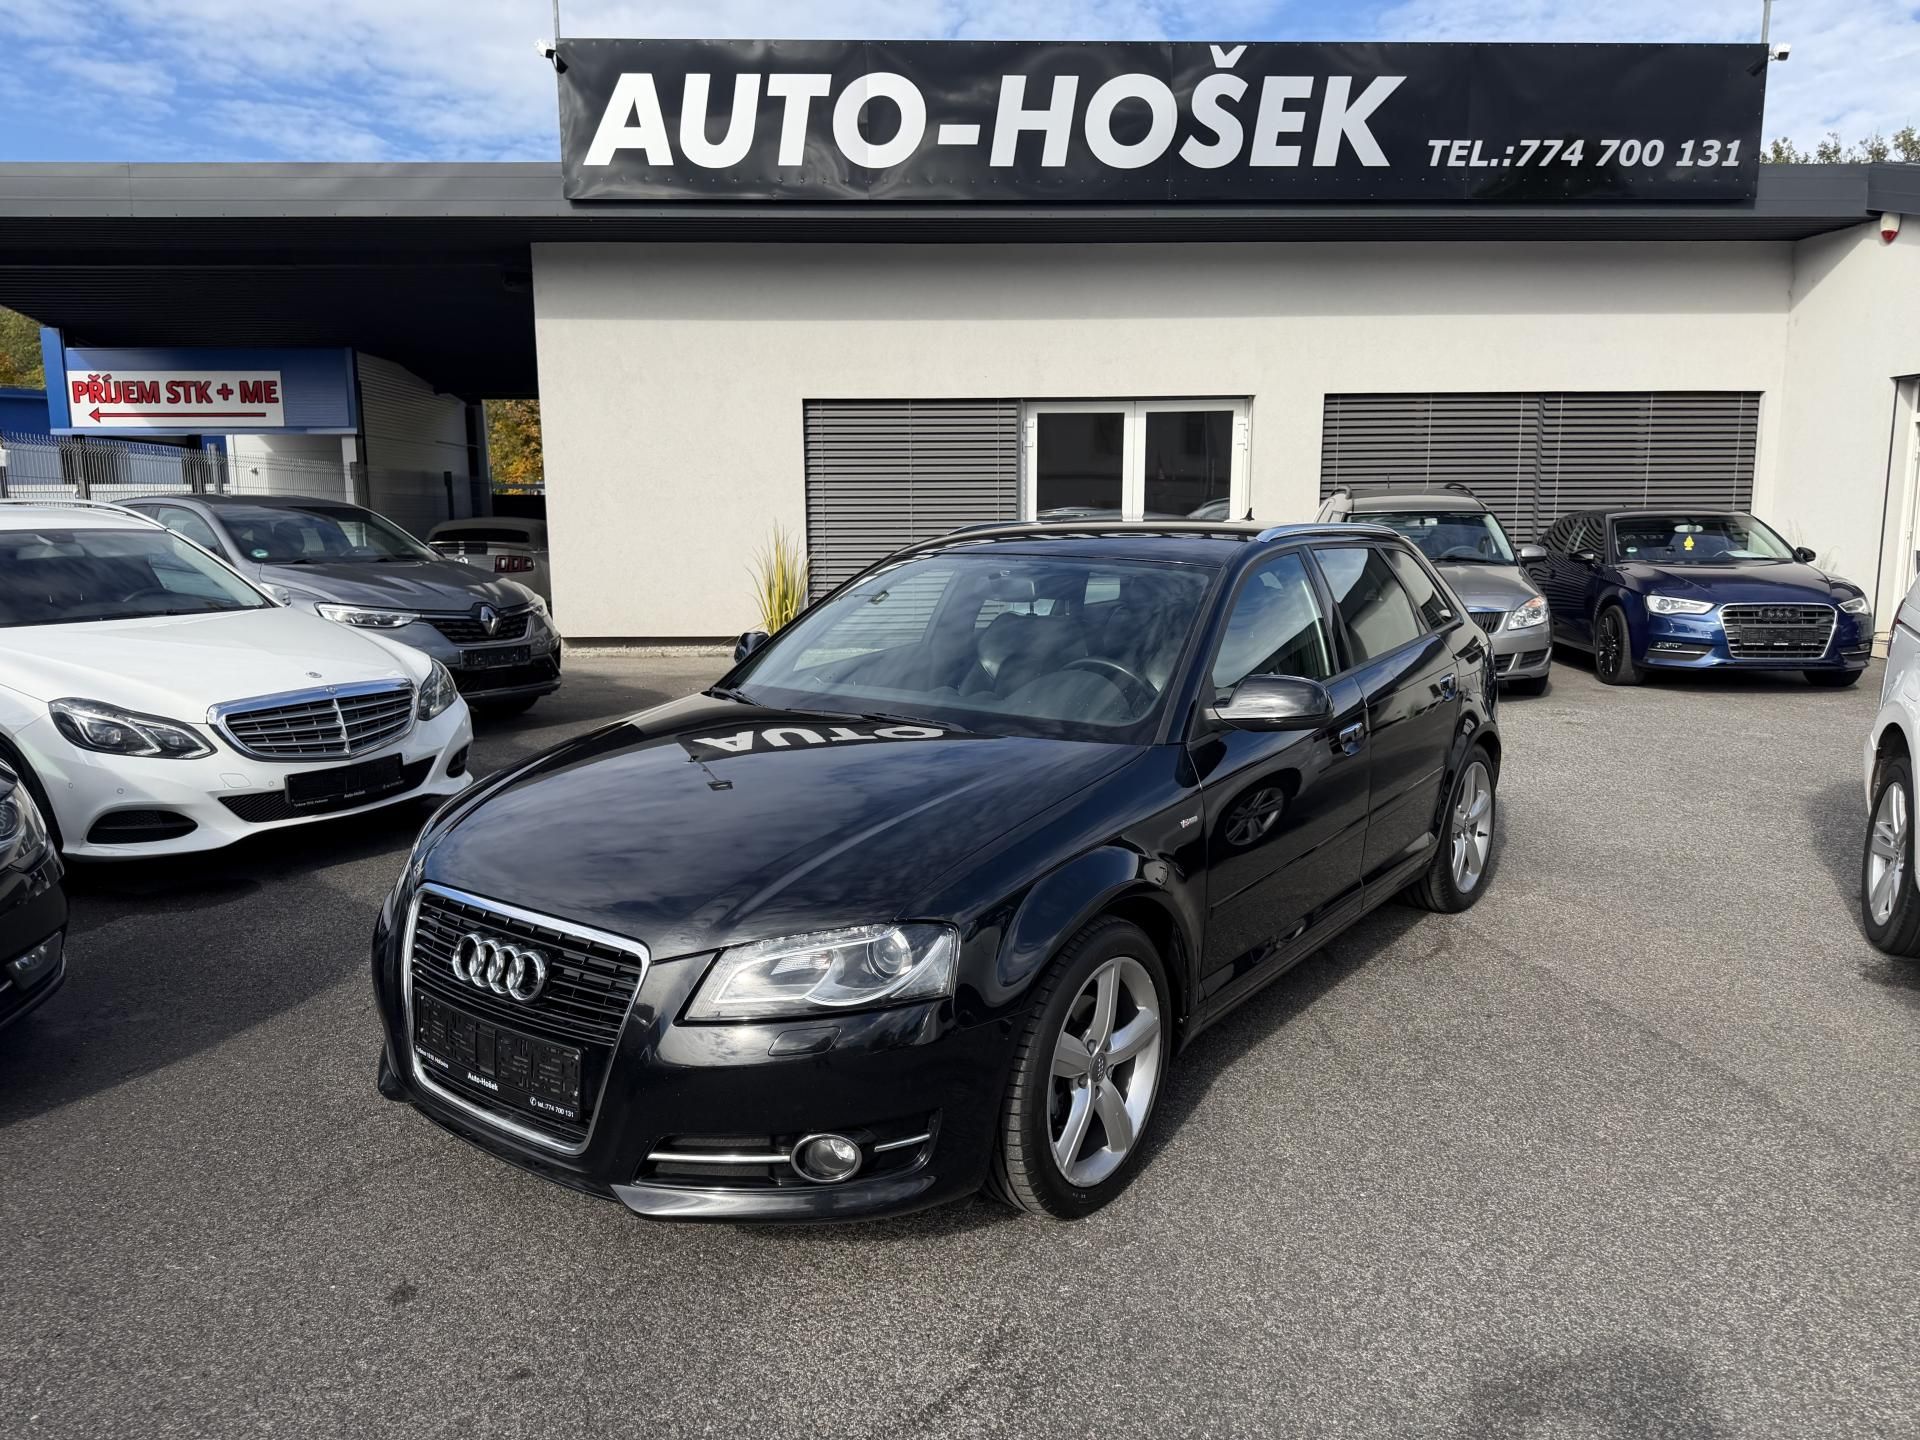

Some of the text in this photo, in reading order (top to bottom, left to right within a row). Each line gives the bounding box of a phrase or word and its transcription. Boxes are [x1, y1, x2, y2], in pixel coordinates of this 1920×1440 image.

[582, 45, 1408, 169] AUTO-HOŠEK
[1427, 138, 1743, 168] TEL.:774 700 131
[71, 373, 161, 404] PŘÍJEM
[165, 380, 214, 404] STK
[239, 380, 280, 404] ME
[555, 1106, 565, 1115] 700
[565, 1109, 574, 1118] 131
